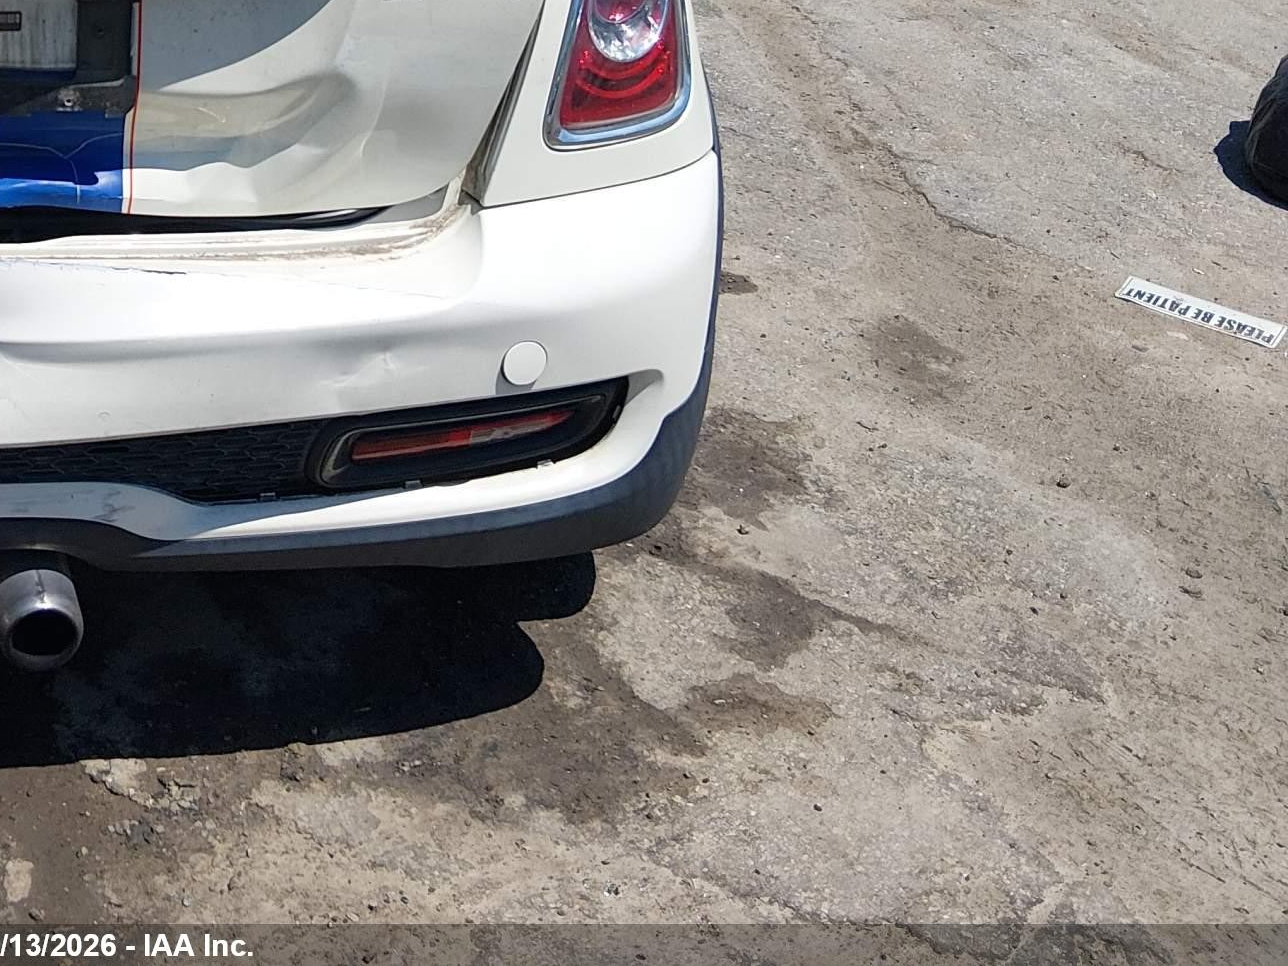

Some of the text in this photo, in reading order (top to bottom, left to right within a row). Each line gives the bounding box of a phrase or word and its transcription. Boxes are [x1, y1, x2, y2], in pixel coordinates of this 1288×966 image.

[1123, 287, 1275, 344] PLEASE BE PATIENT
